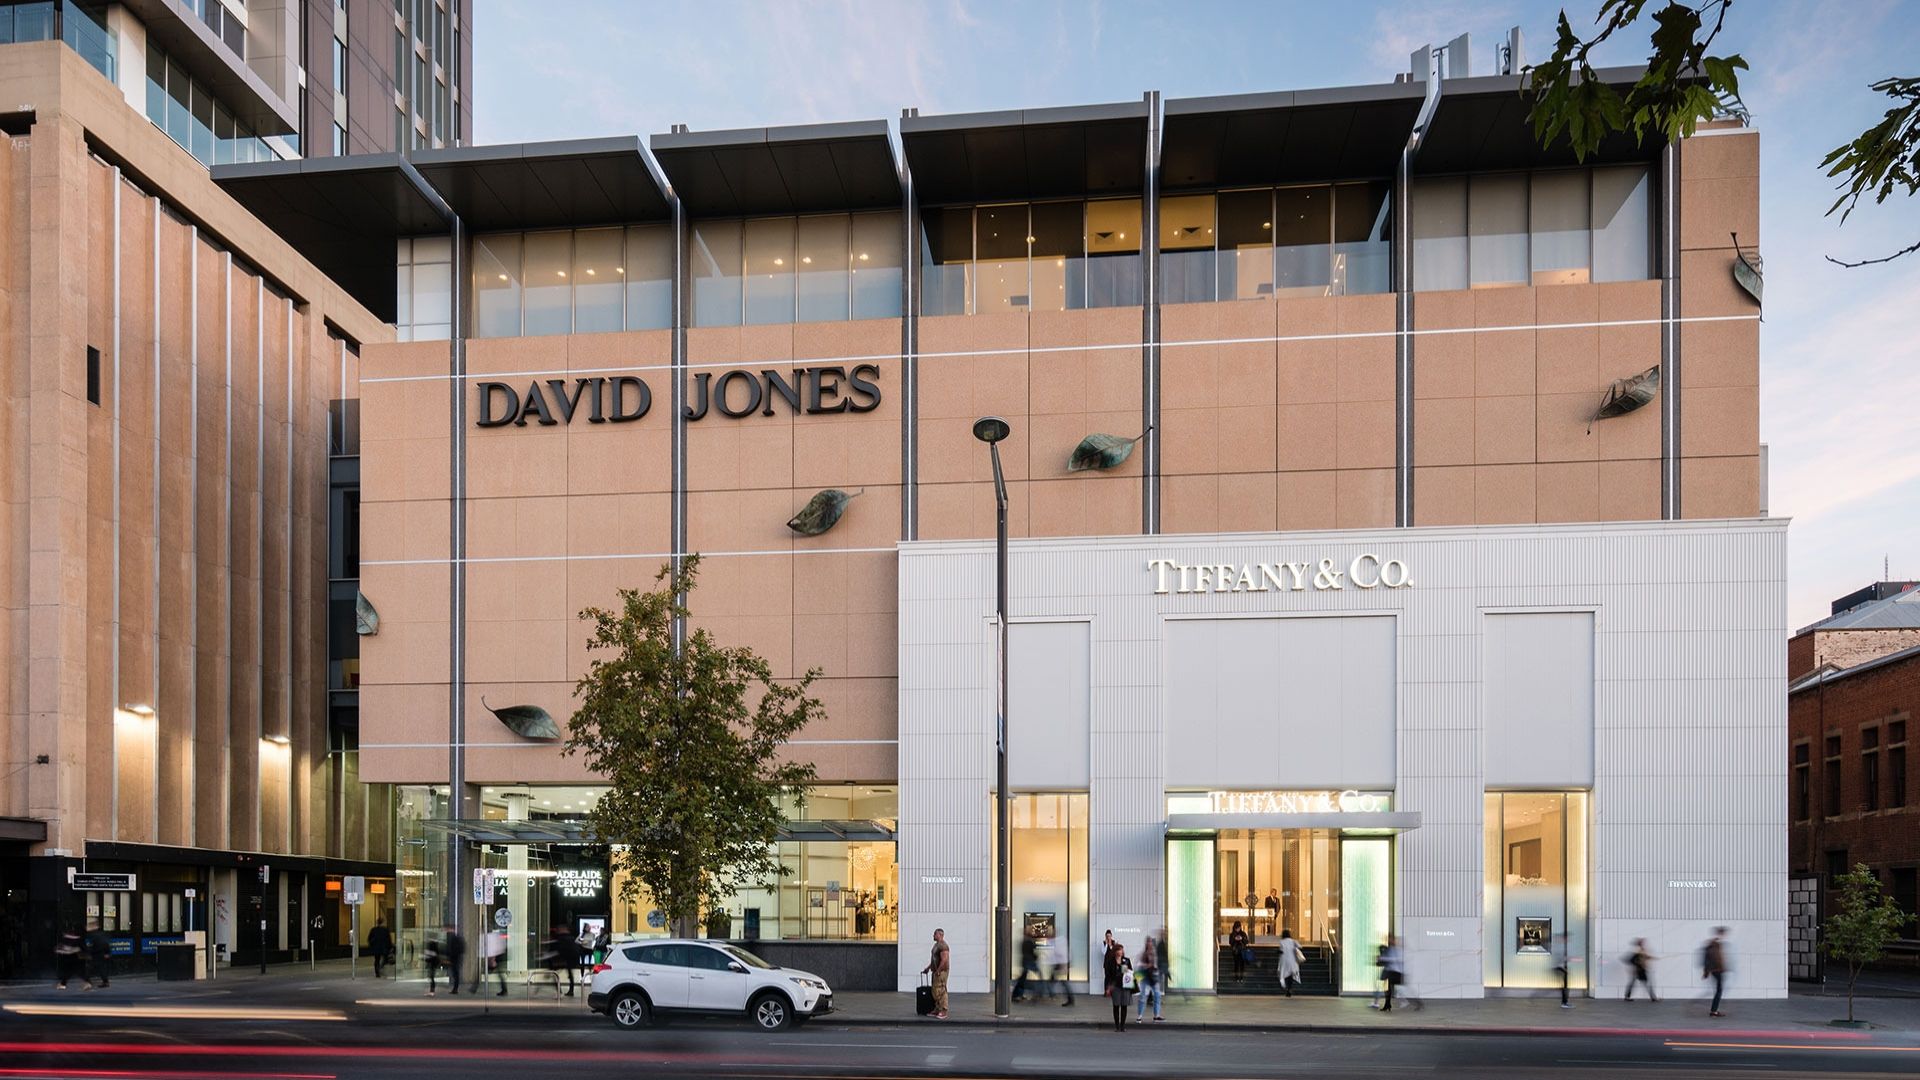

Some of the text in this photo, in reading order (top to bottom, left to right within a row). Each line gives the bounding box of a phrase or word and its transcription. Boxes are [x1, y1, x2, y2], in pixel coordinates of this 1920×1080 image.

[476, 363, 882, 427] DAVID JONES
[1147, 558, 1310, 595] TIFFANY
[1313, 558, 1343, 591] &
[1208, 790, 1314, 814] TIFFANY
[1315, 792, 1337, 813] &
[556, 869, 603, 880] ADELAIDE
[556, 879, 603, 888] CENTRAL
[563, 888, 596, 897] PLAZA
